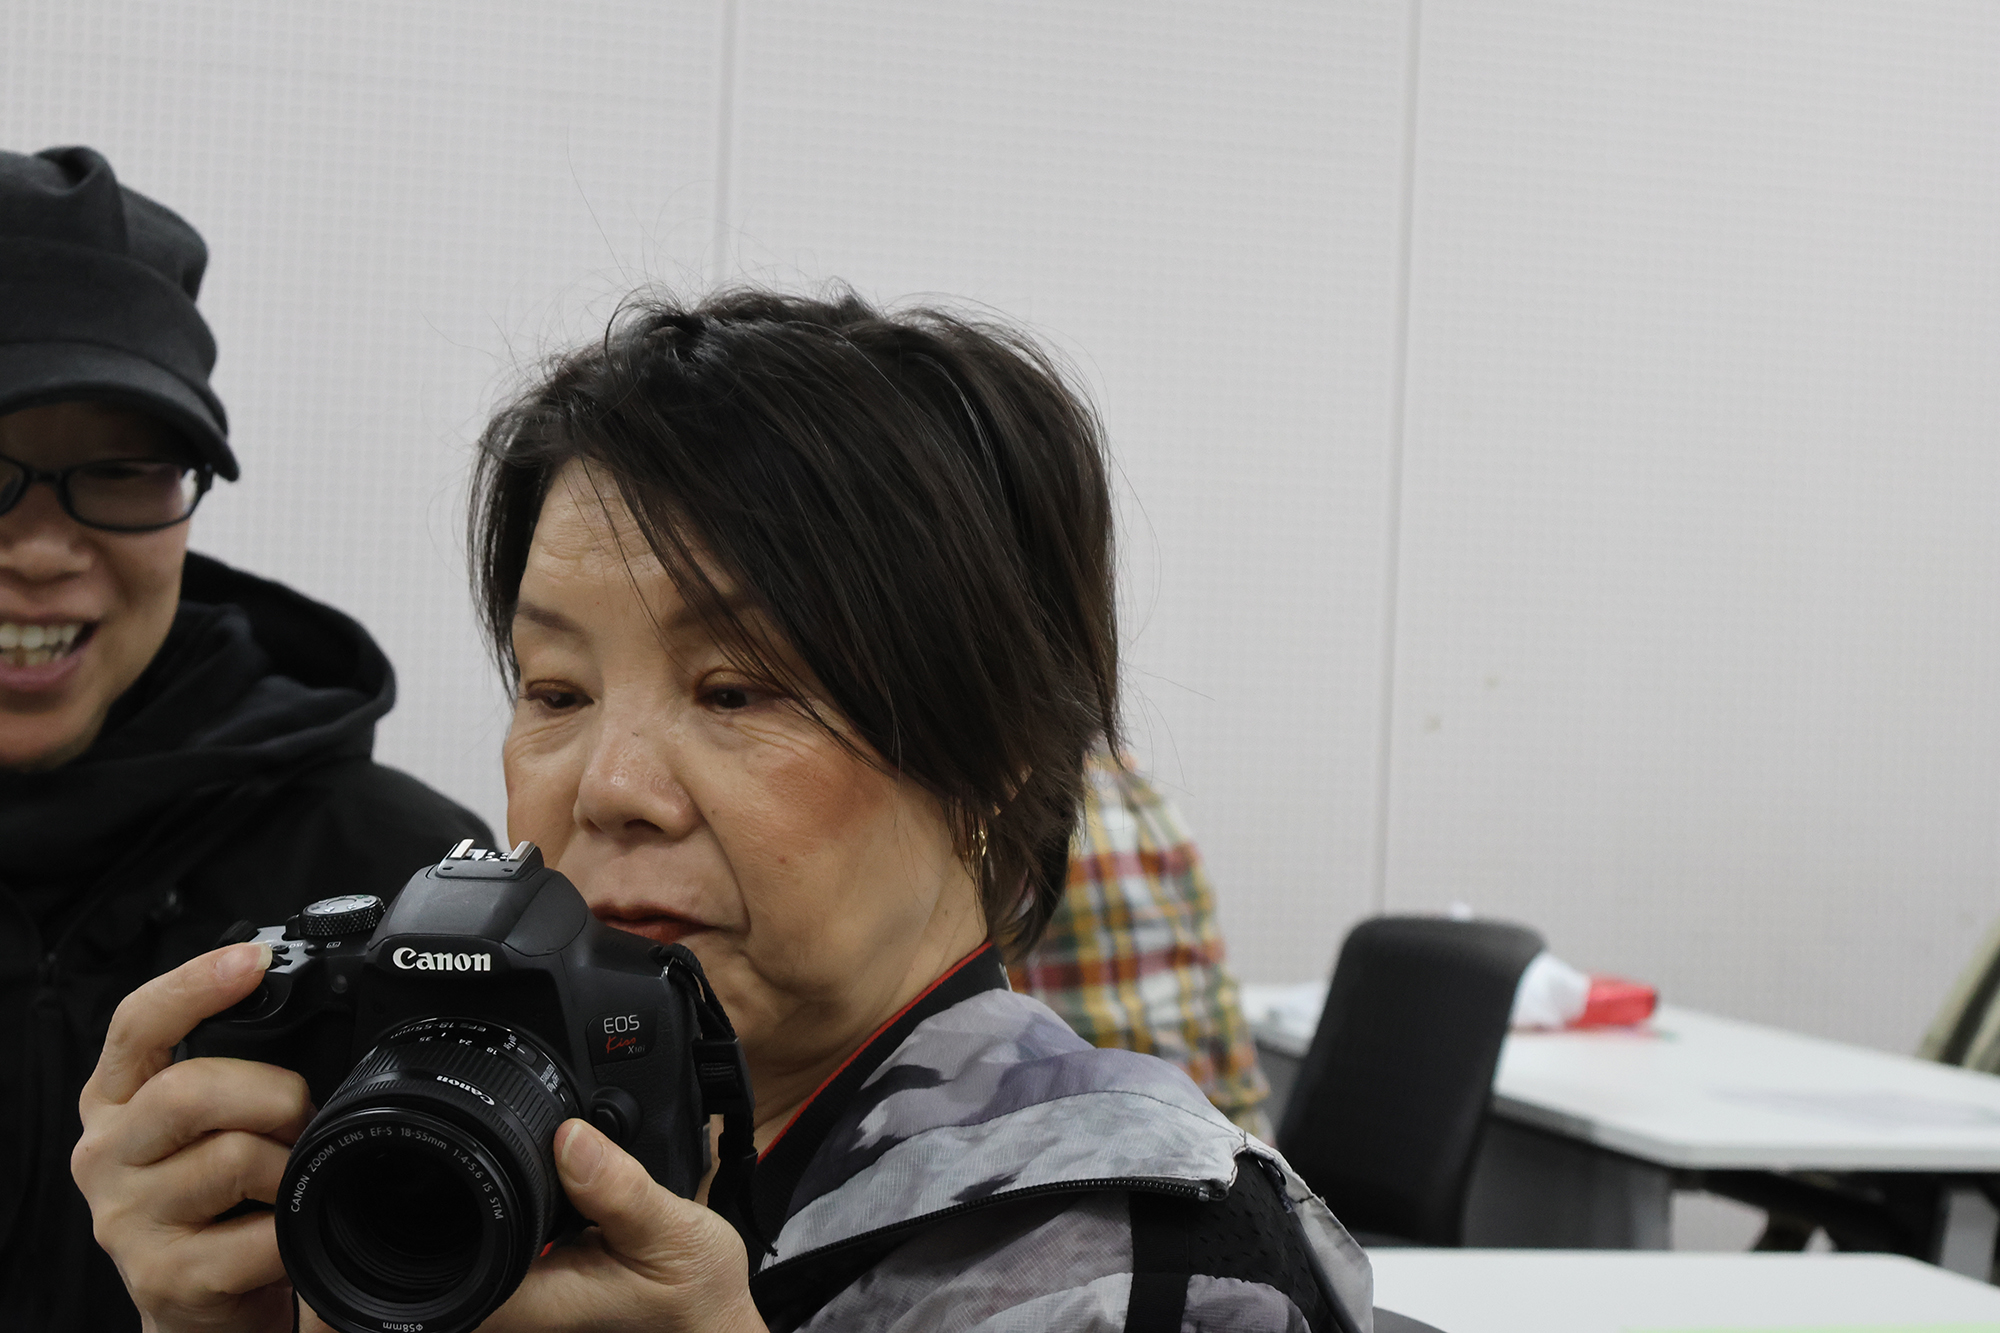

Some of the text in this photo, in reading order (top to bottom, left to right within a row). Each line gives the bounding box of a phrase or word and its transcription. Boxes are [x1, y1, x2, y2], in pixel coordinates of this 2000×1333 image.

[392, 946, 491, 972] Canon
[603, 1014, 641, 1034] EOS
[458, 1038, 473, 1046] 24
[605, 1035, 637, 1054] Kiss
[436, 1074, 495, 1106] Canon
[290, 1126, 504, 1220] CANON ZOOM LENS EF-S 18-55mm 1:4-5.6 IS STM
